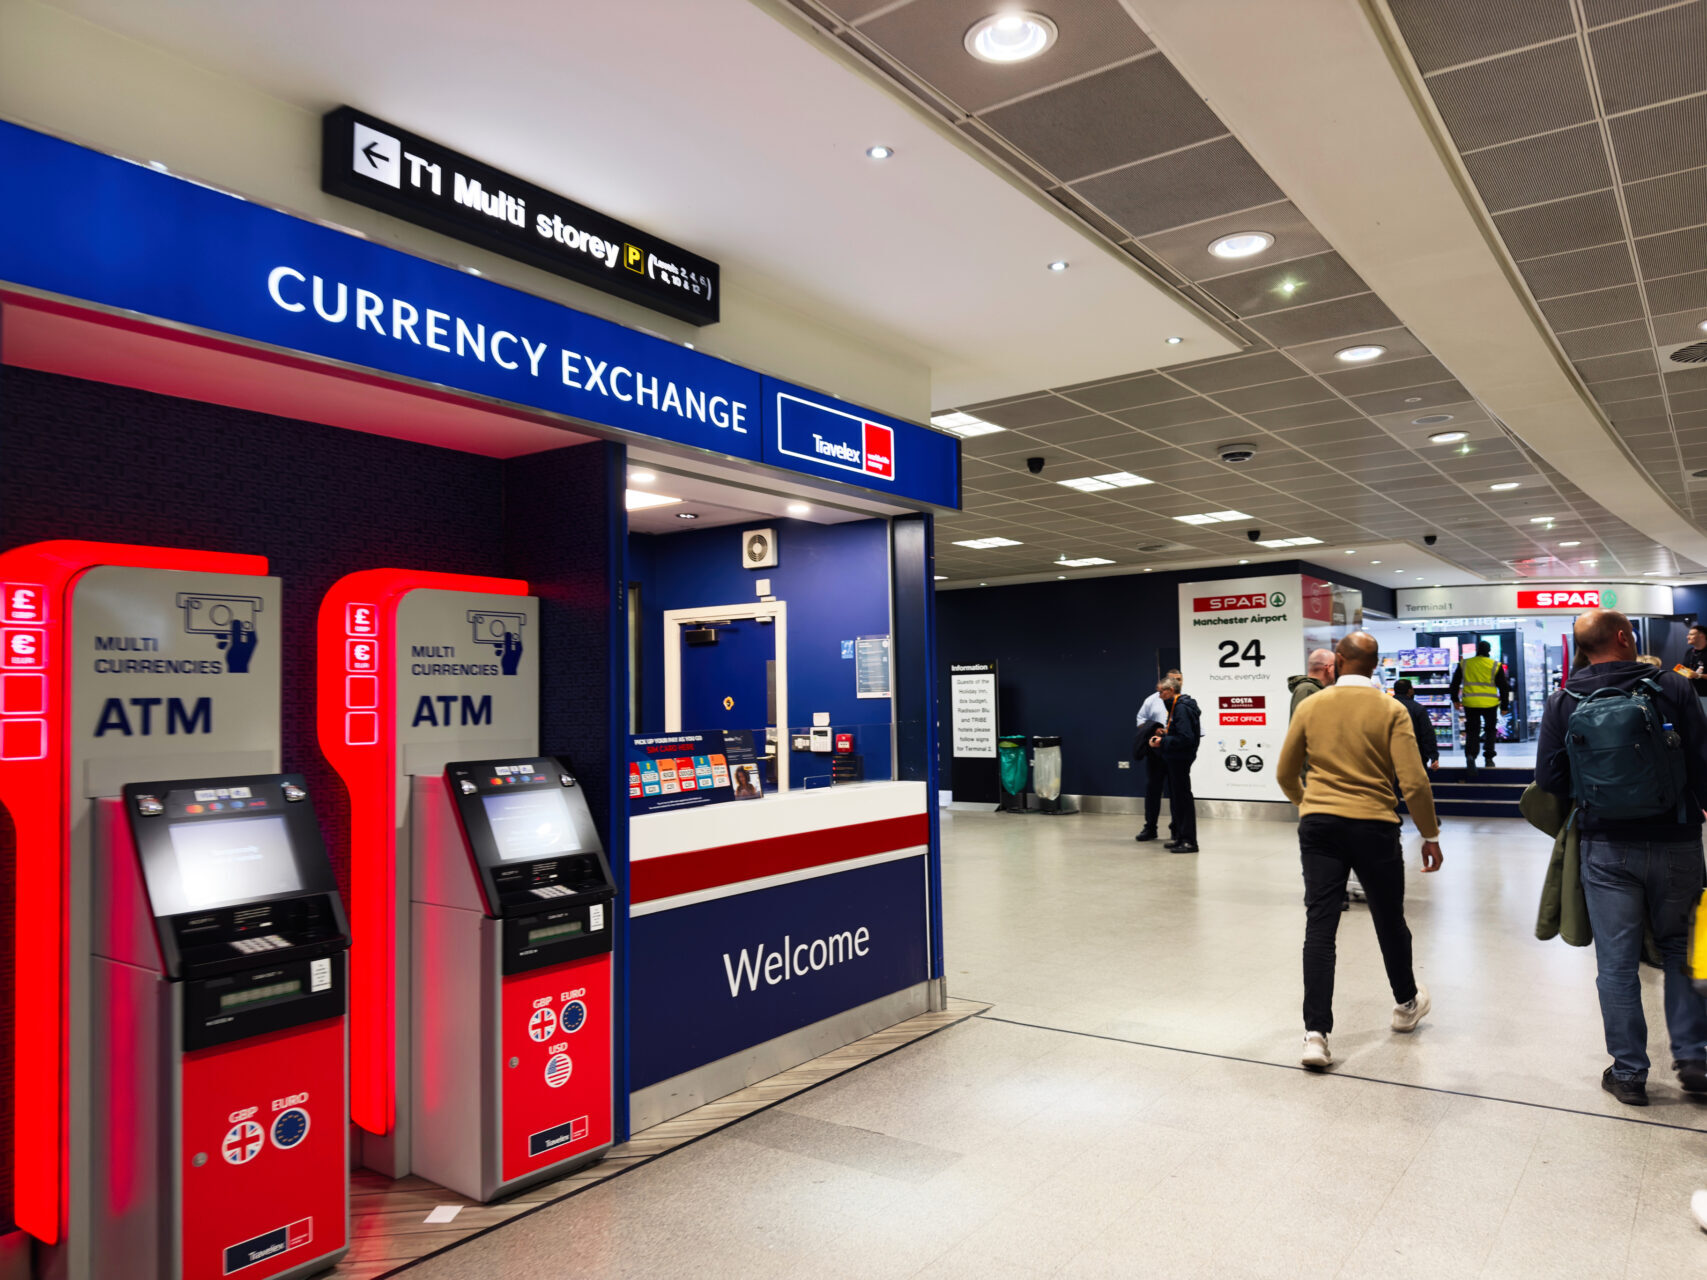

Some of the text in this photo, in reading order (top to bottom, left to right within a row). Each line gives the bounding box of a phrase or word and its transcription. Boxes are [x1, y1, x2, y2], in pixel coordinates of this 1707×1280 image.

[404, 152, 442, 196] T1
[454, 172, 526, 229] Multi
[536, 213, 620, 269] storey
[267, 265, 748, 434] CURRENCY EXCHANGE
[812, 433, 861, 464] Travelex
[1209, 595, 1265, 609] SPAR
[1536, 592, 1599, 606] SPAR
[1406, 603, 1447, 612] Terminal
[1193, 613, 1287, 626] Manchester Airport
[94, 636, 158, 652] MULTI
[411, 646, 455, 658] MULTI
[1218, 639, 1266, 668] 24
[94, 659, 222, 675] CURRENCIES
[411, 664, 499, 676] CURRENCIES
[1234, 673, 1270, 681] everyday
[93, 697, 213, 737] ATM
[411, 695, 492, 727] ATM
[660, 744, 677, 752] CARD
[723, 926, 870, 998] Welcome
[533, 988, 586, 1009] GBP EURO
[548, 1042, 568, 1055] USD
[228, 1092, 309, 1124] GBP EURO
[248, 1242, 285, 1262] Travelex
